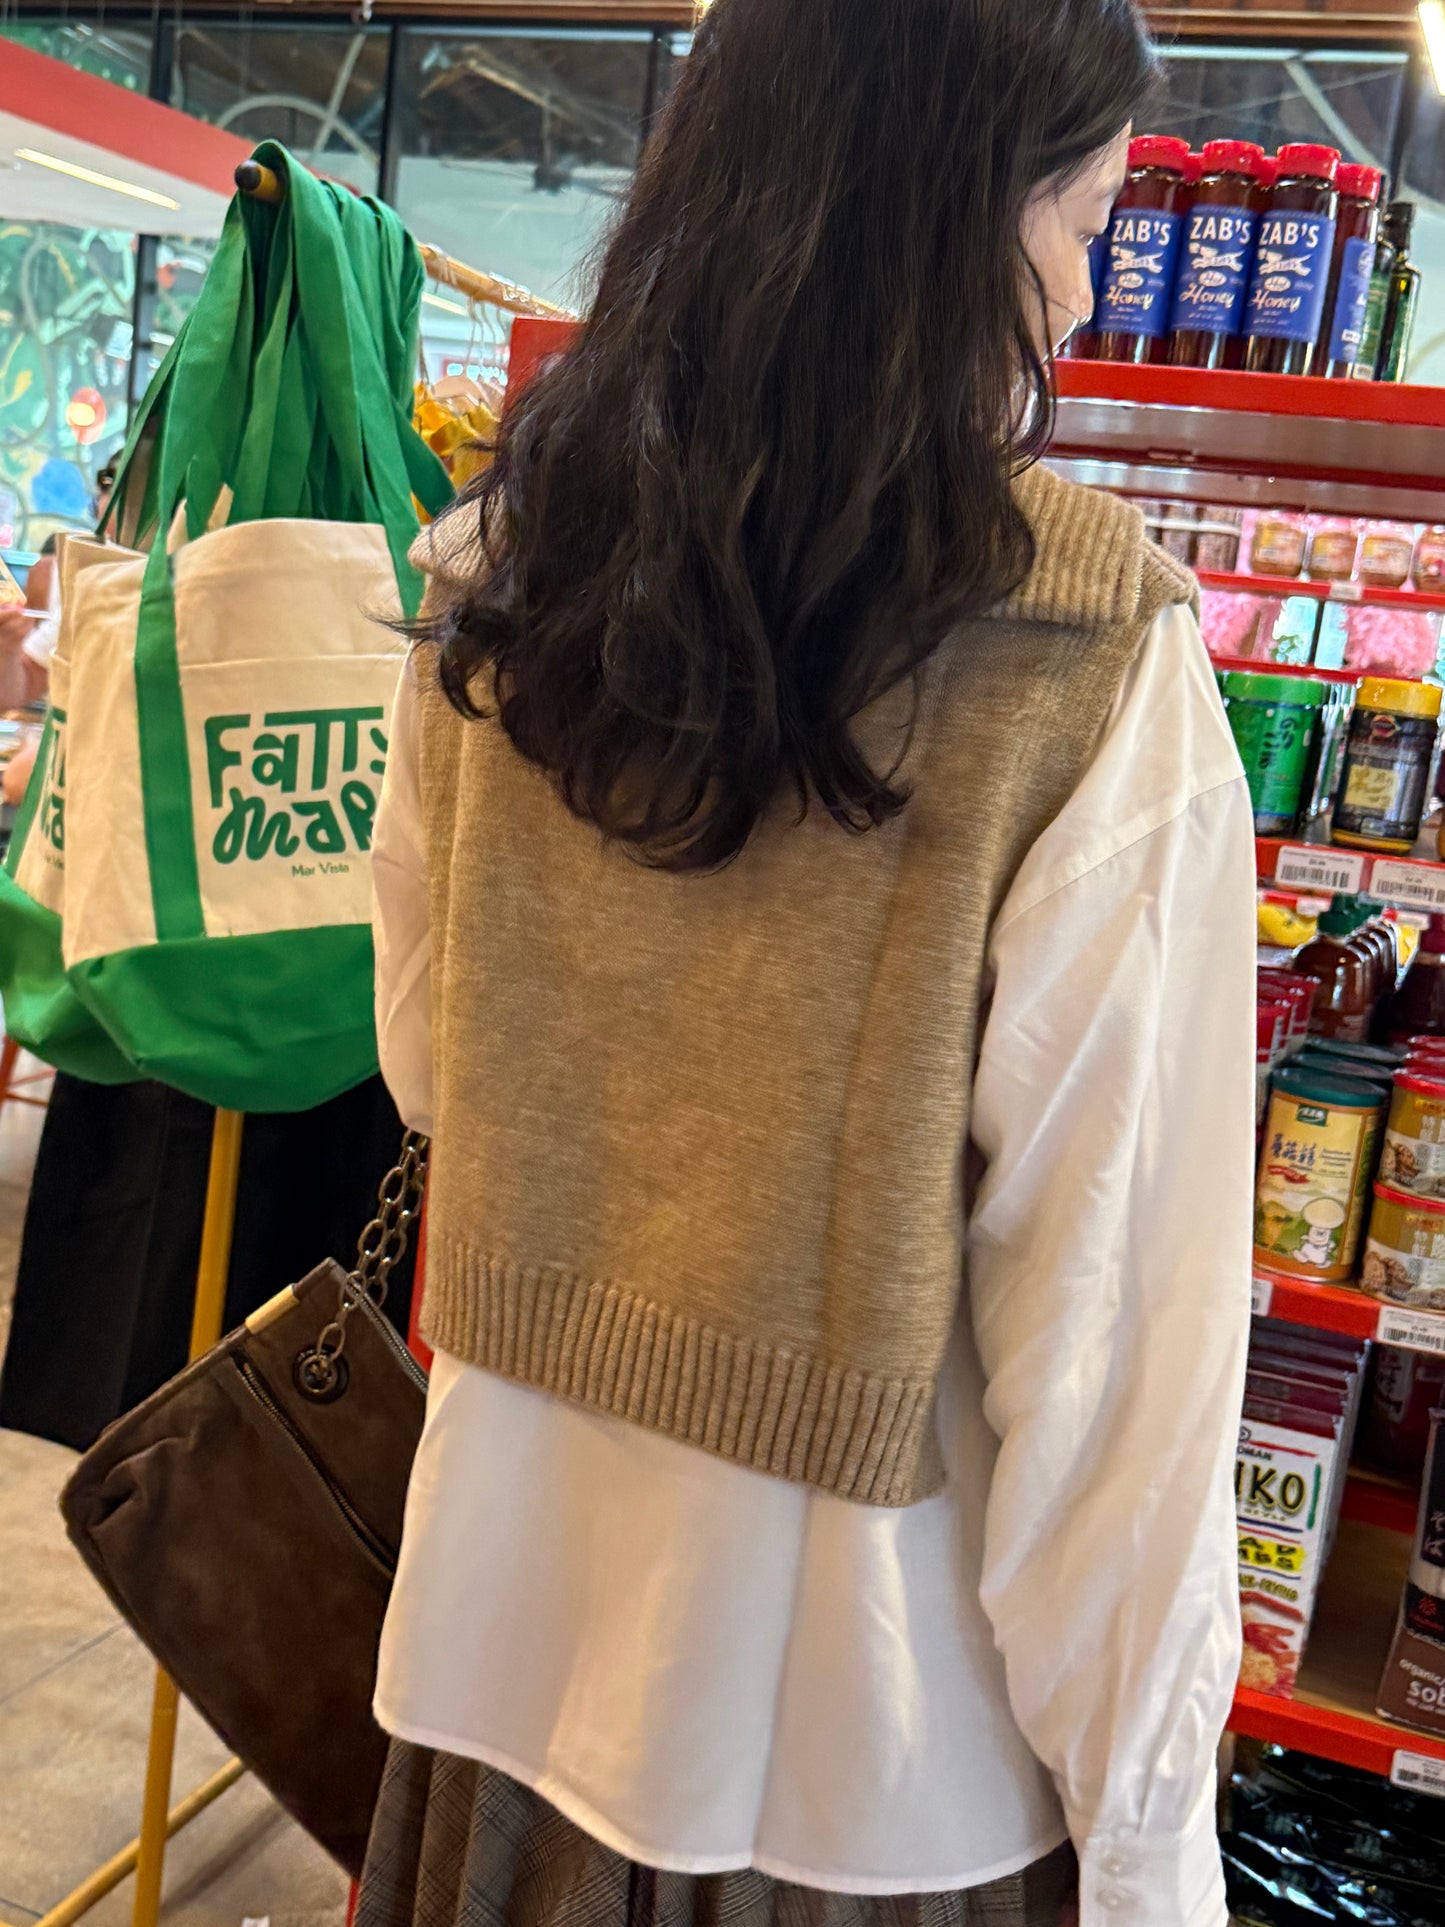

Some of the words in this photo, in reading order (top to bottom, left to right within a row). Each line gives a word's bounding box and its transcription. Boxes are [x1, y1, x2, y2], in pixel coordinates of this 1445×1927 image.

[1112, 219, 1172, 246] ZAB'S
[1189, 216, 1252, 244] ZAB'S
[1259, 222, 1320, 248] ZAB'S
[1105, 285, 1155, 311] Honey
[1179, 282, 1235, 309] Honey
[1250, 289, 1302, 313] Honey
[291, 864, 315, 878] Mar
[318, 861, 350, 876] Vista
